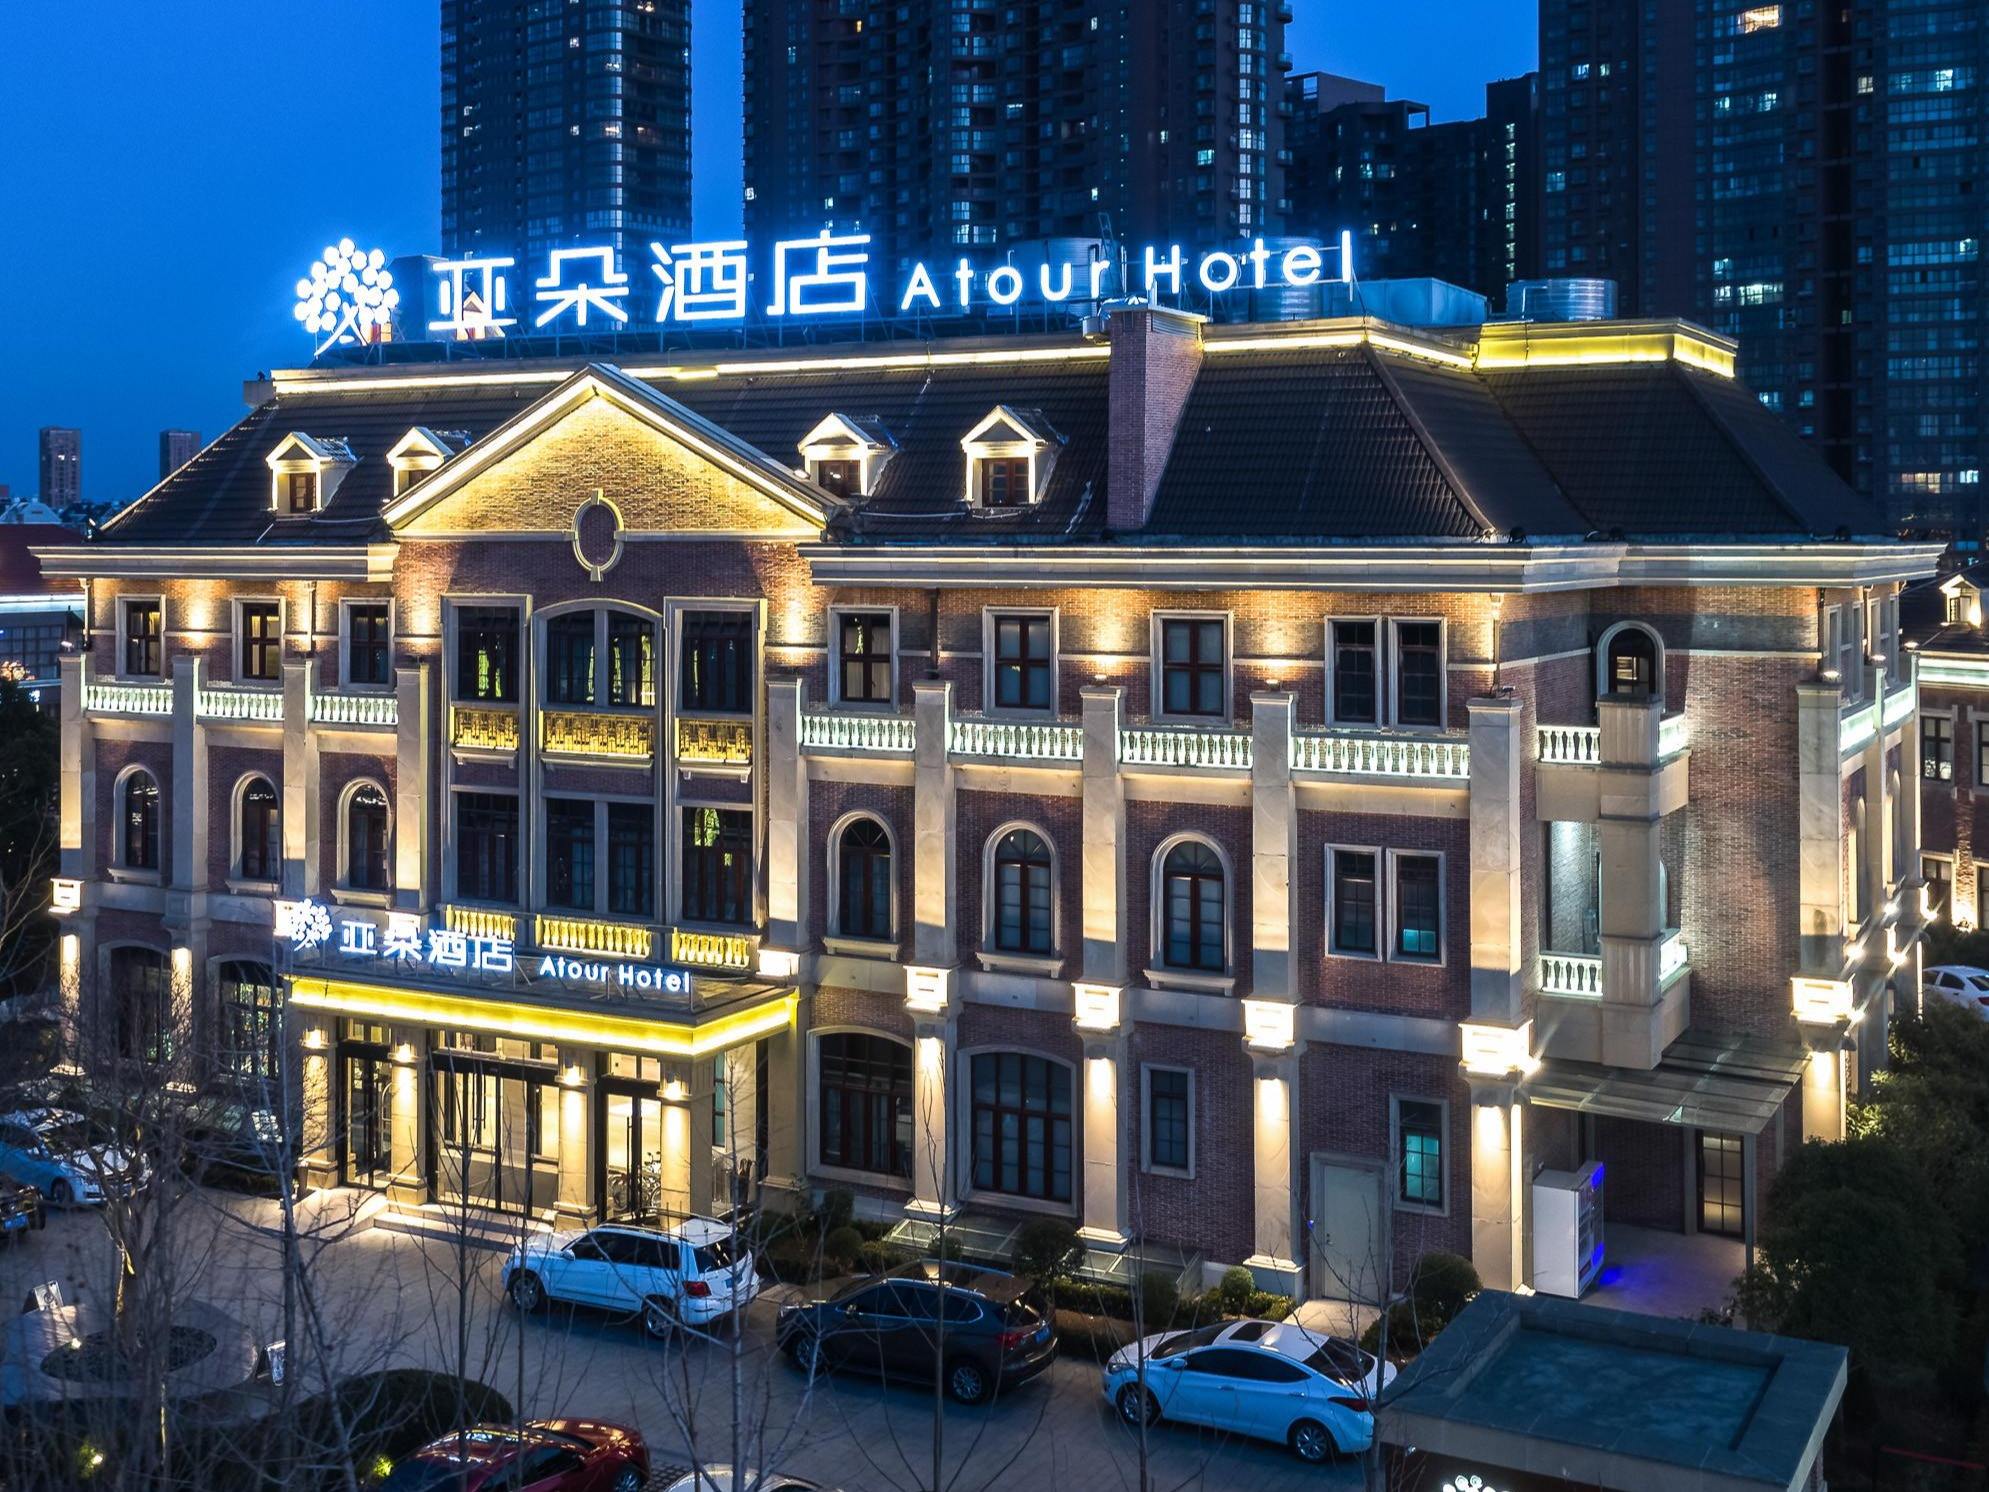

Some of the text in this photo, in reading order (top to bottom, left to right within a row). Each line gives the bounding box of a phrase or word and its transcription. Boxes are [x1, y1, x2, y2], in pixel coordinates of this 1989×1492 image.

[428, 229, 872, 338] 亚朵酒店
[900, 229, 1352, 310] Atour Hotel
[339, 919, 514, 972] 亚朵酒店
[539, 955, 690, 993] Atour Hotel
